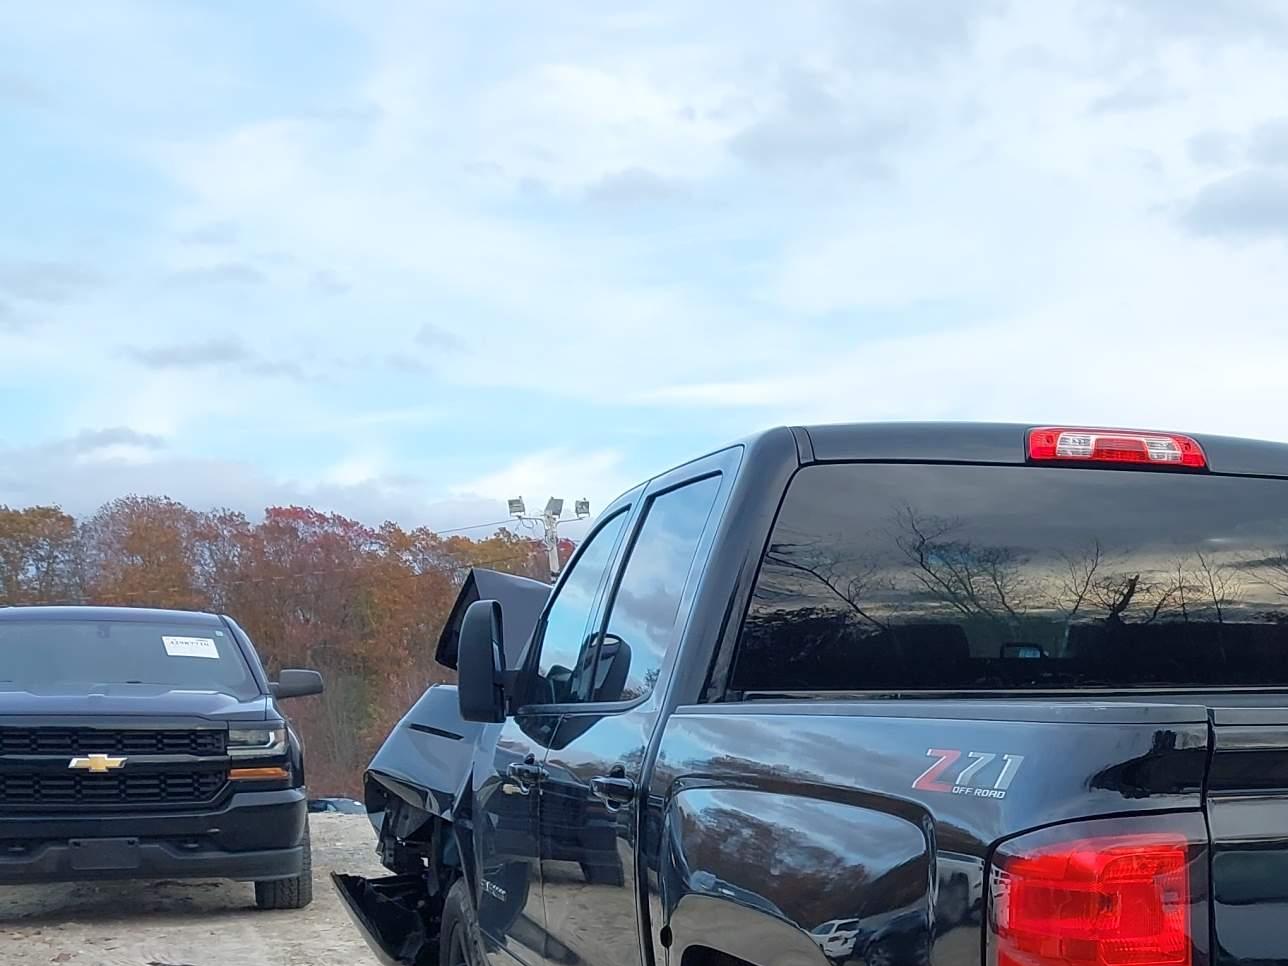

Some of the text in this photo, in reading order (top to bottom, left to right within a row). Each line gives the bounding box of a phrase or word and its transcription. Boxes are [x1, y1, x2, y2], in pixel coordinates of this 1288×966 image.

[911, 748, 1025, 793] Z71
[952, 785, 1006, 799] OFF ROAD
